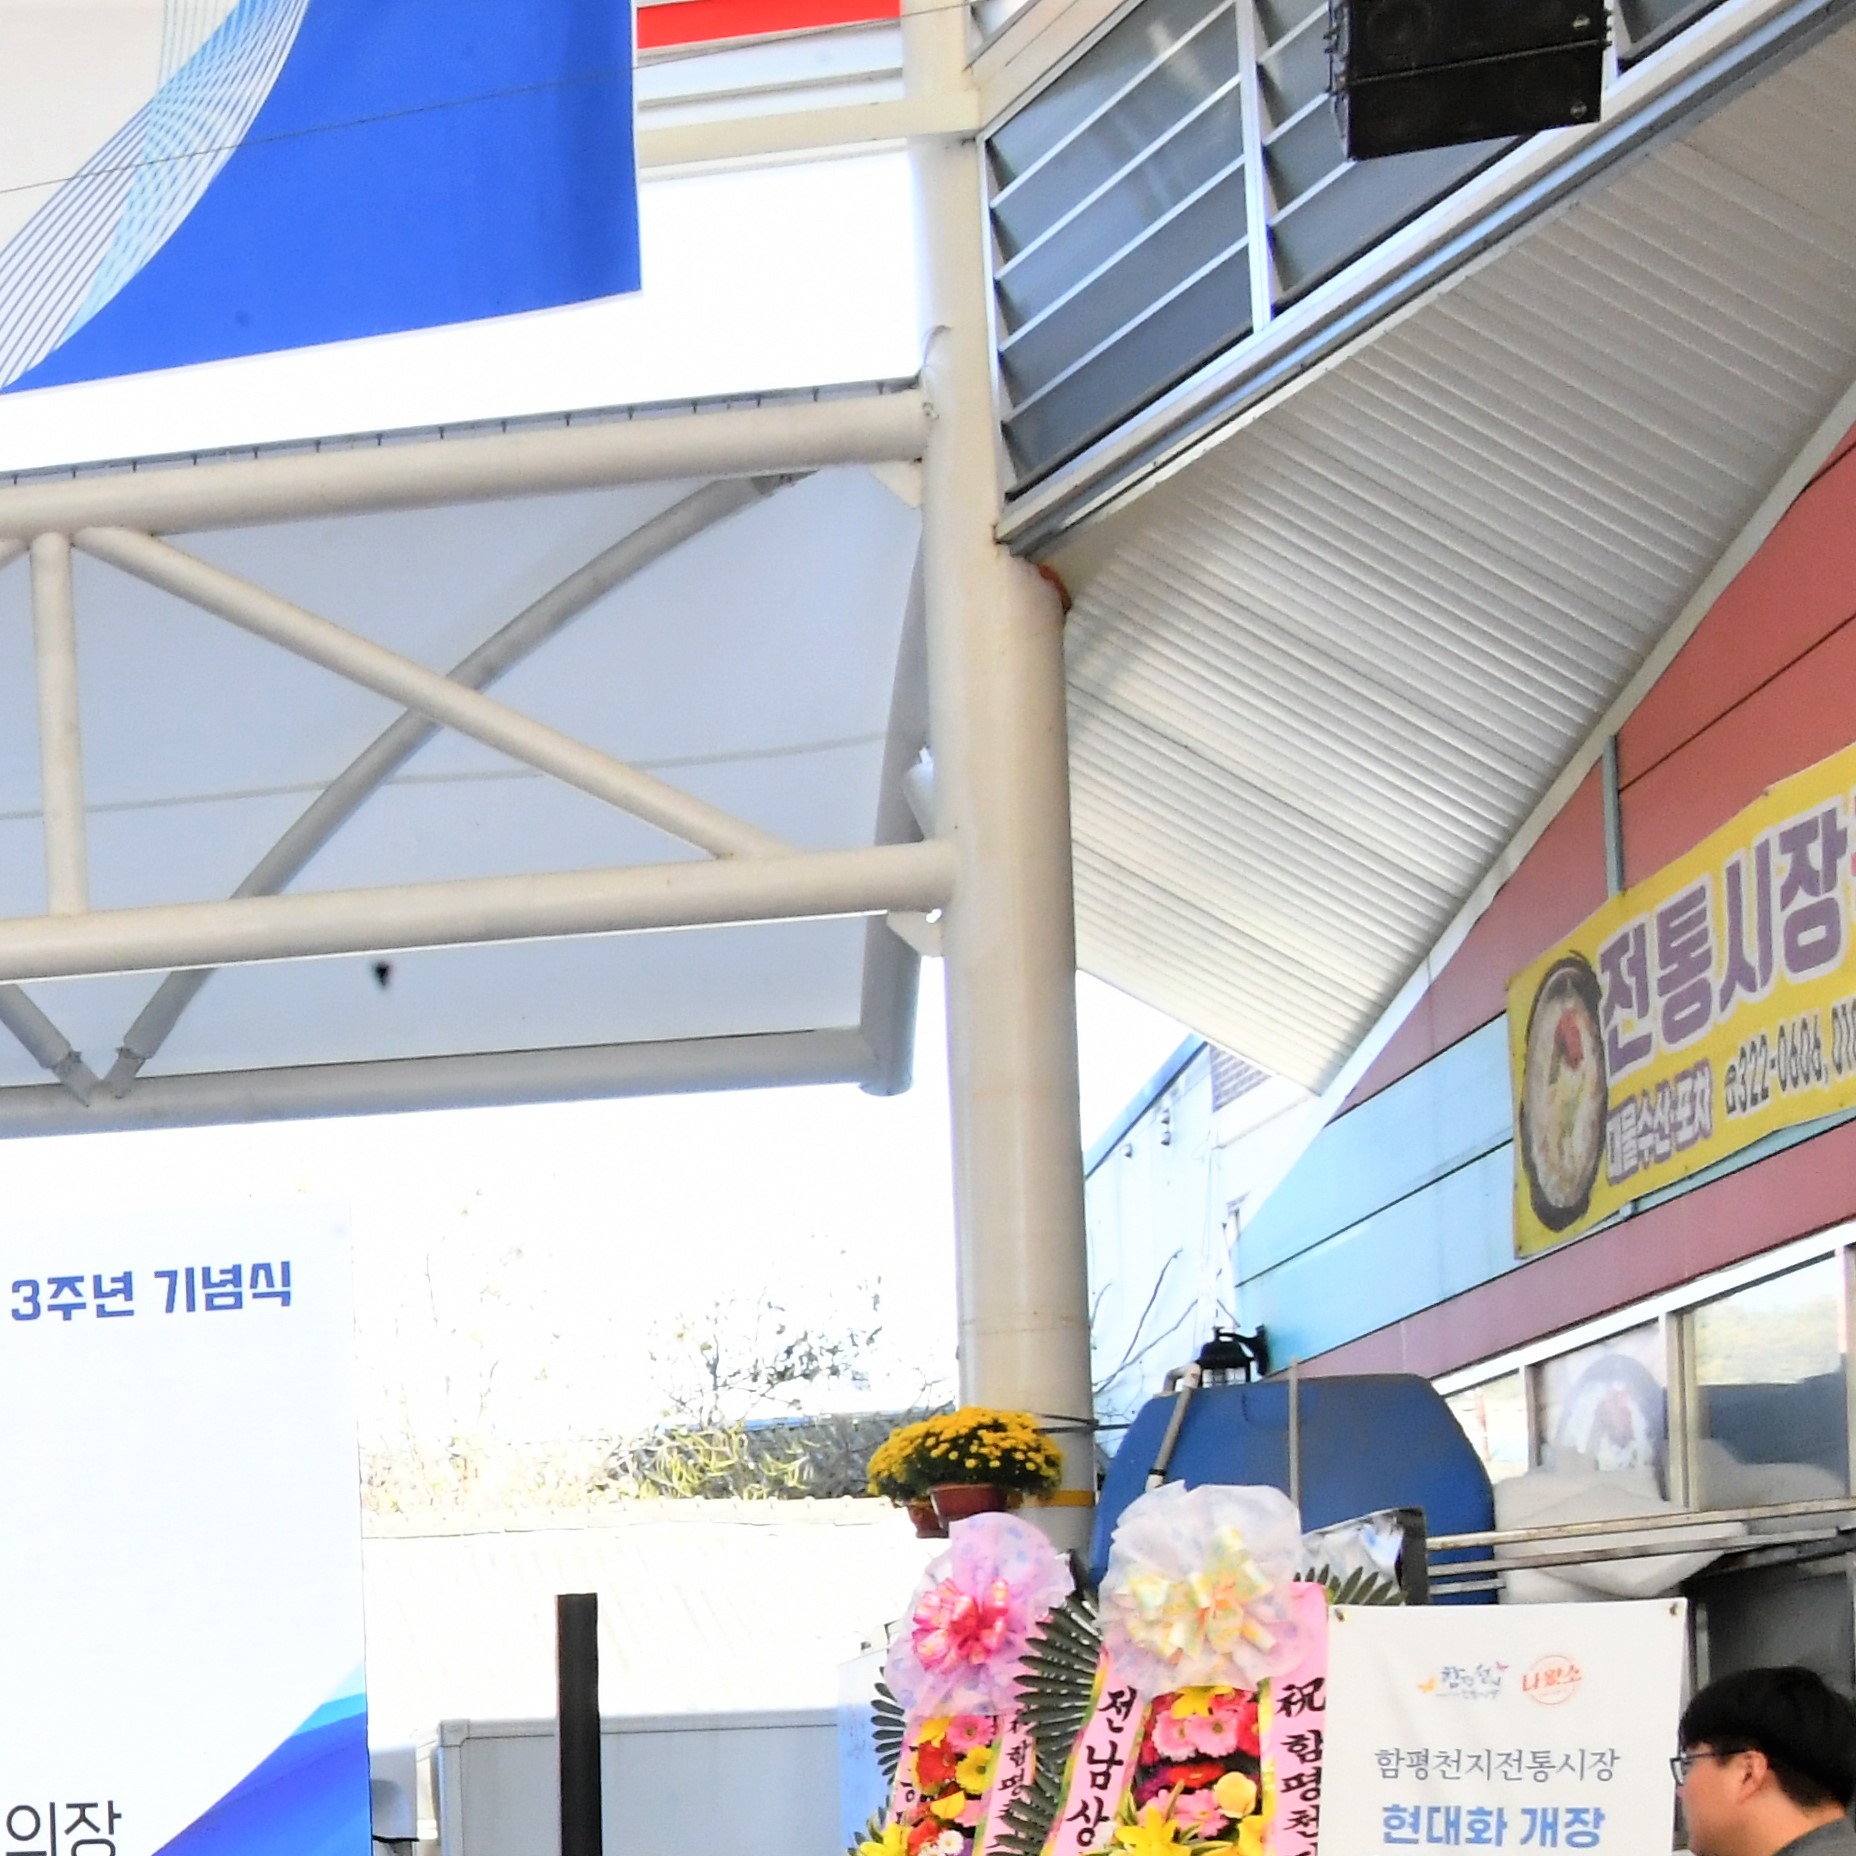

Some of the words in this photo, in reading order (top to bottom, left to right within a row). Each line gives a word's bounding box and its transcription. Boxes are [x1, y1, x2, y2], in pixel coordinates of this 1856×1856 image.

[1598, 804, 1850, 1073] 전통시장
[7, 1267, 138, 1324] 3주년
[152, 1260, 294, 1315] 기념식
[1373, 1746, 1622, 1783] 함평천지전통시장
[1382, 1803, 1508, 1848] 현대화
[1519, 1805, 1607, 1850] 개장
